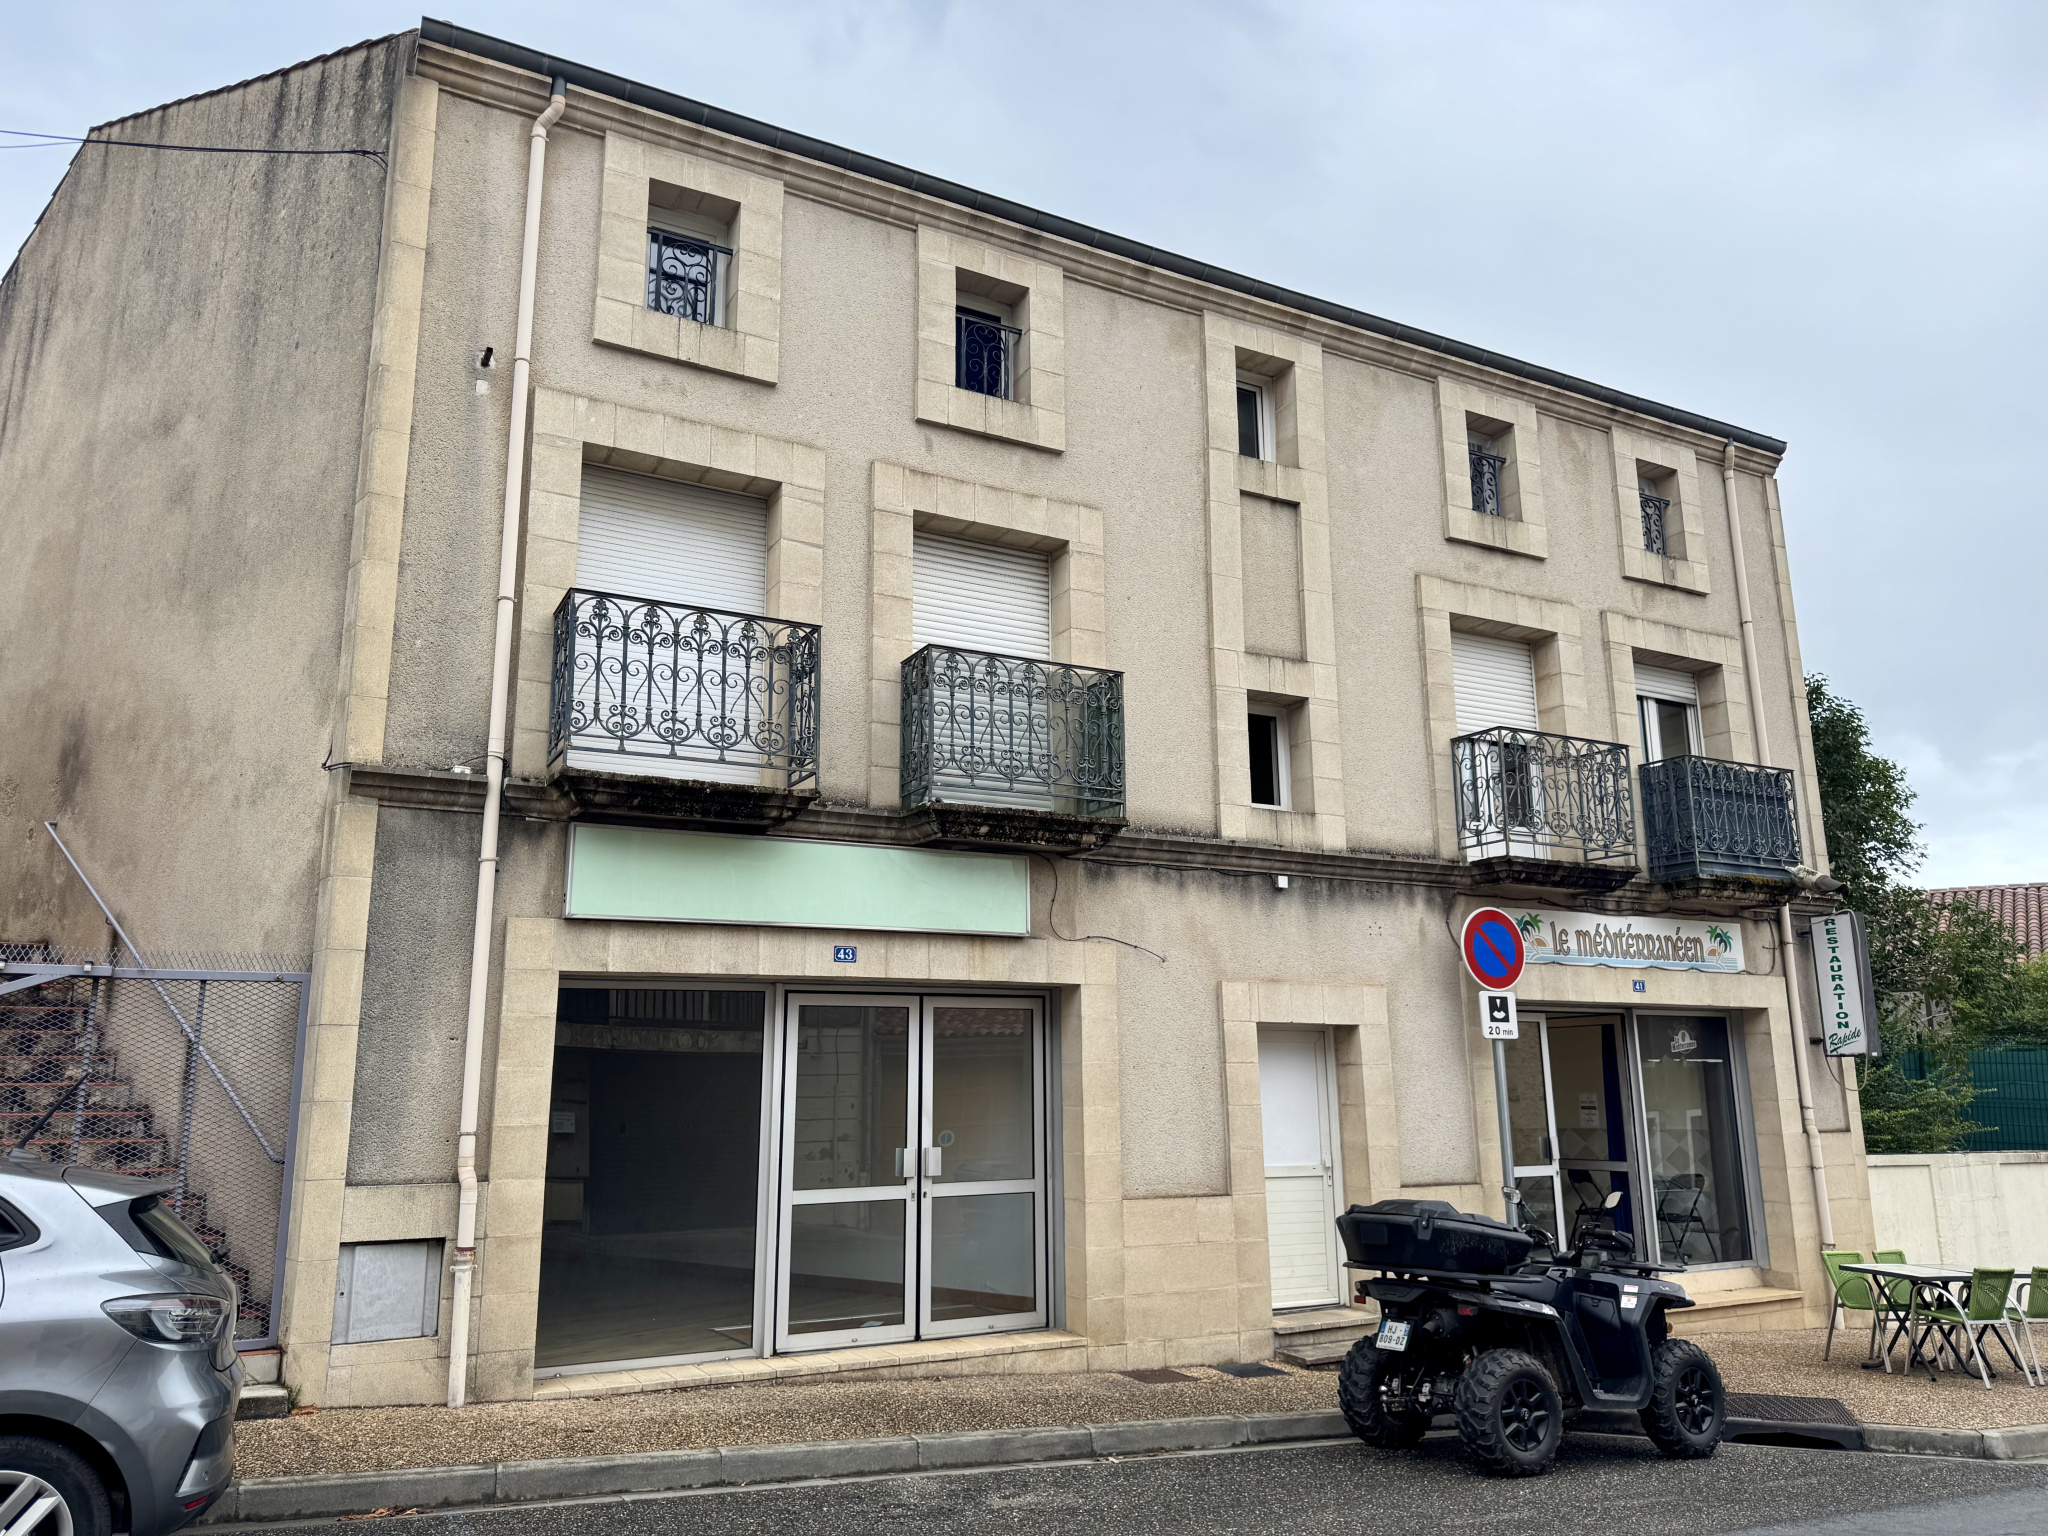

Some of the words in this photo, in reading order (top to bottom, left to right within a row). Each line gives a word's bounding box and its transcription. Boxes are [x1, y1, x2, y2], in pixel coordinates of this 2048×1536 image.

[1550, 920, 1570, 956] le
[837, 948, 853, 959] 43
[1824, 918, 1849, 1029] RESTAURATION
[1635, 981, 1643, 990] 41
[1488, 1026, 1501, 1035] 20
[1502, 1028, 1514, 1036] min
[1829, 1027, 1861, 1050] Rapide
